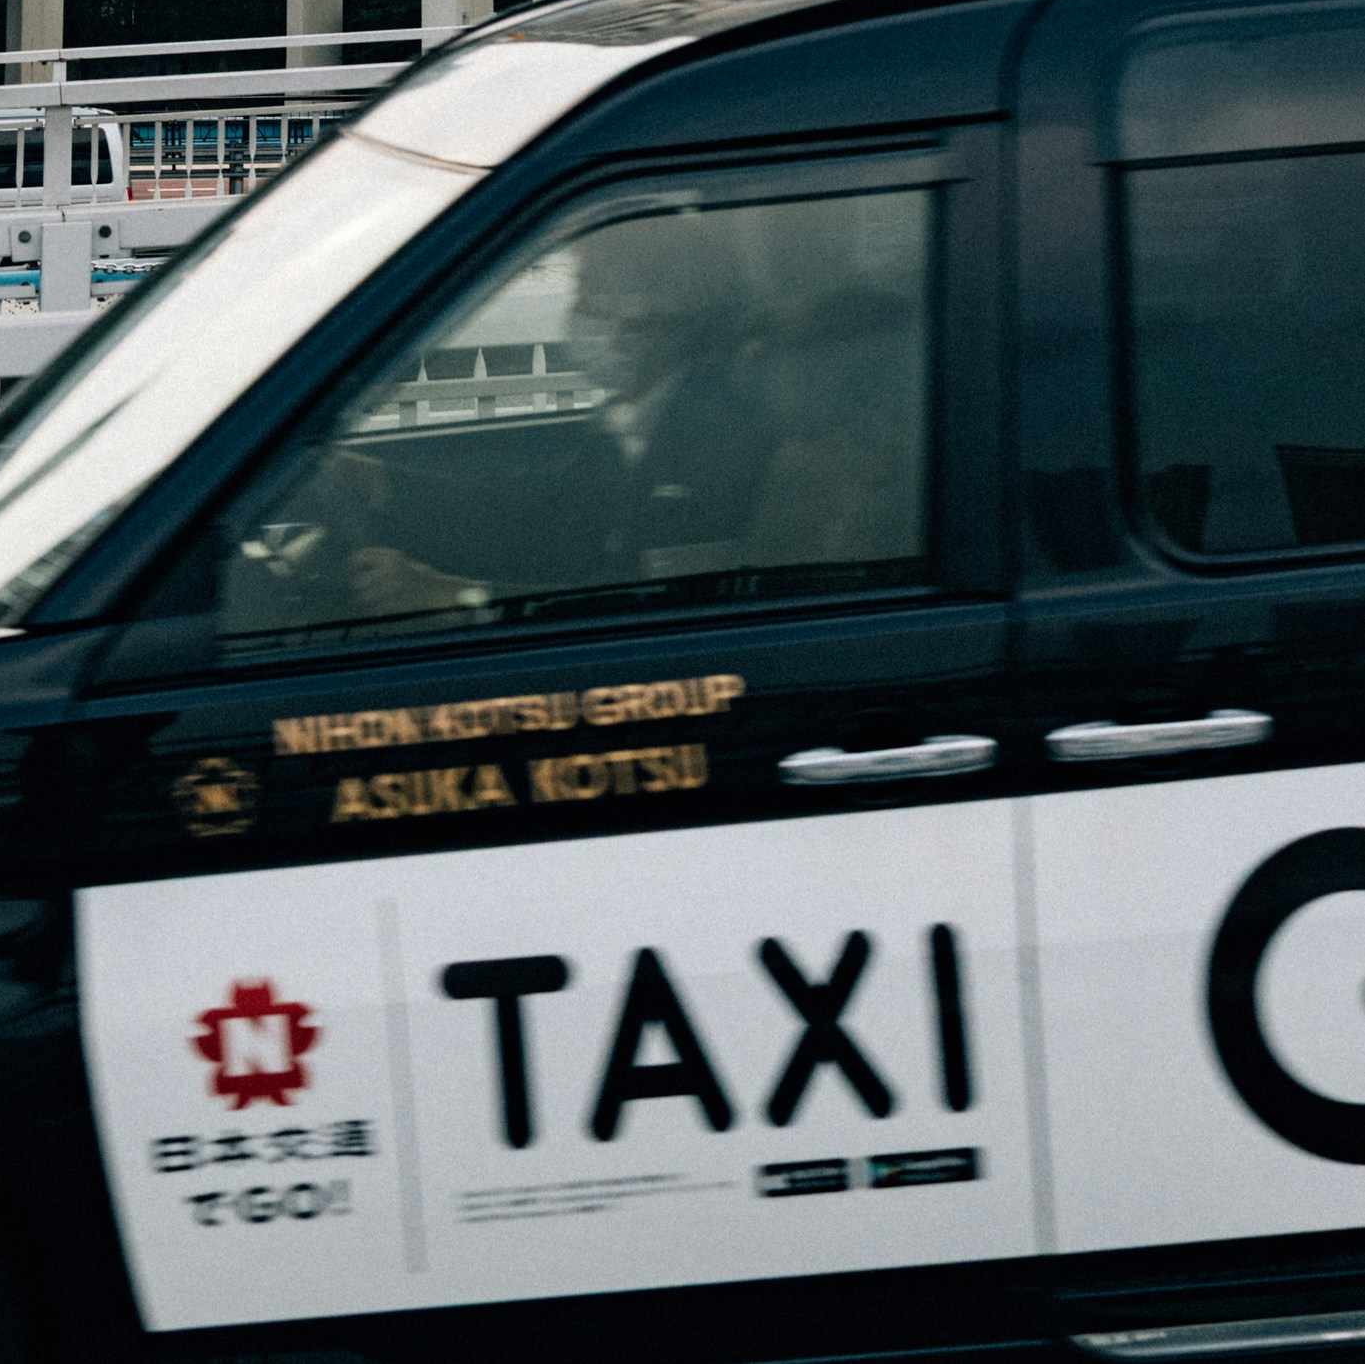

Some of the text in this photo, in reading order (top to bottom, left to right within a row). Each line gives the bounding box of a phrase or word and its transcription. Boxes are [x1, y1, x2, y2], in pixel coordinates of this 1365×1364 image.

[330, 764, 517, 823] ASUKA
[530, 743, 709, 803] KOTSU
[440, 923, 974, 1151] TAXI
[148, 1119, 376, 1173] 日本交通
